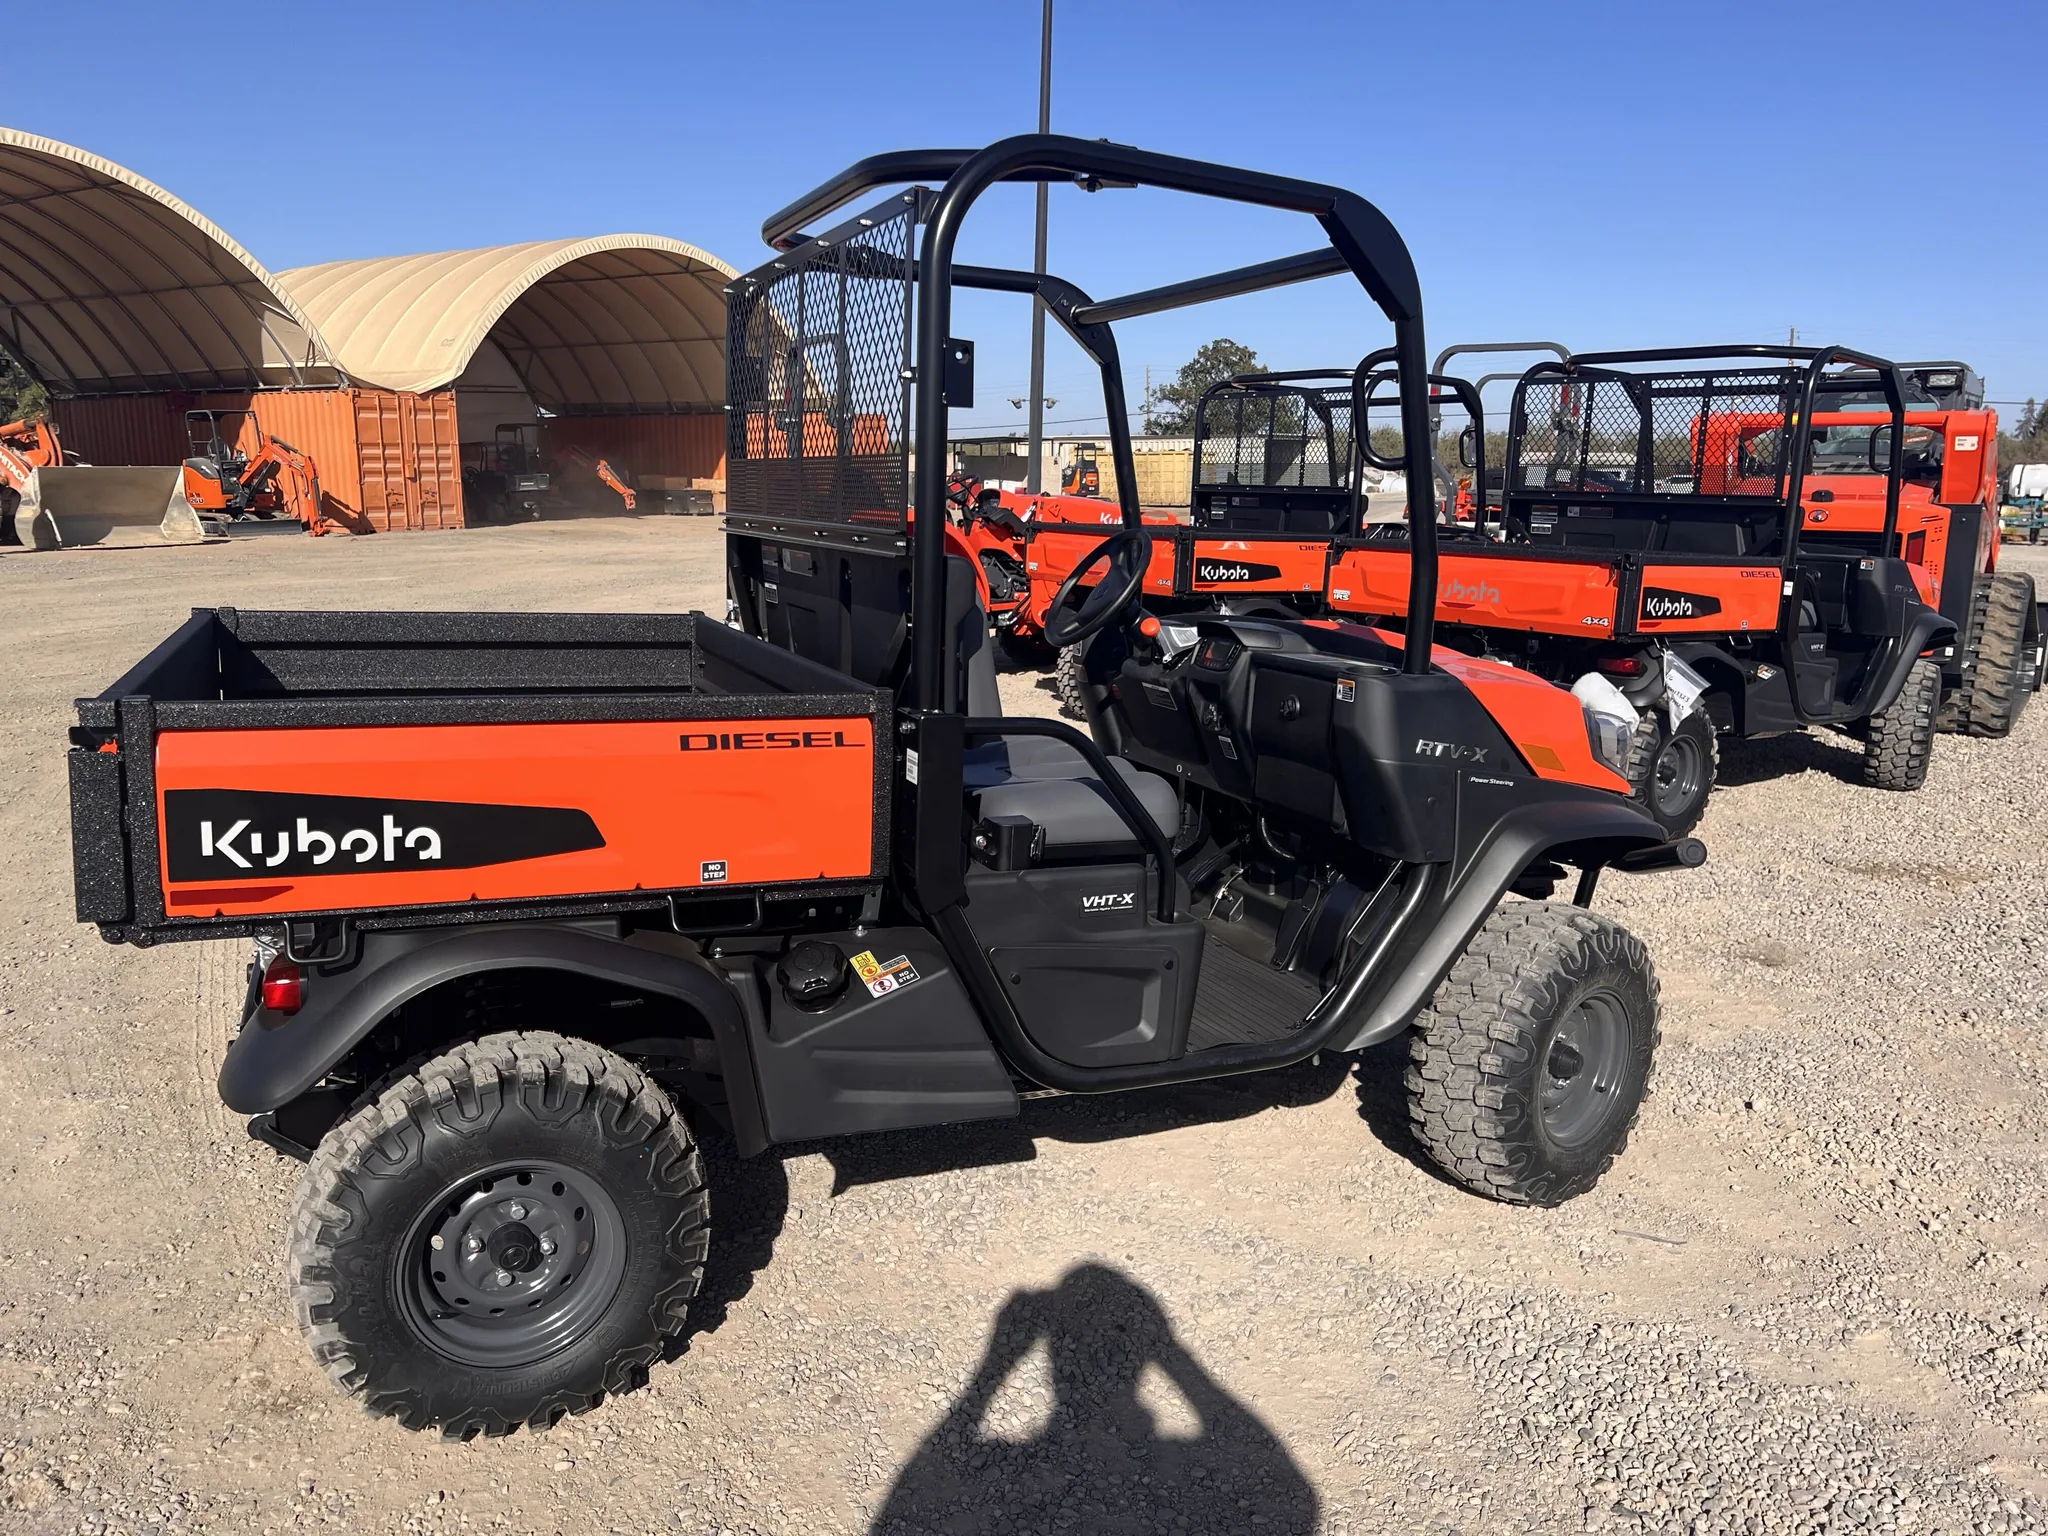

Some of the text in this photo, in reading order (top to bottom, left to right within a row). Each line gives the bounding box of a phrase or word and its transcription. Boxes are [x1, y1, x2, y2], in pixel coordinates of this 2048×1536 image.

[1201, 565, 1249, 580] Kubota
[1740, 570, 1780, 578] DIESEL
[1439, 578, 1499, 603] ubota
[1646, 597, 1693, 617] Kubota
[1581, 616, 1610, 627] 4x4
[680, 732, 865, 751] DIESEL
[1415, 739, 1488, 763] RTV-X
[1470, 776, 1514, 787] Power Steering
[200, 814, 443, 869] Kubota
[708, 863, 721, 871] NO
[703, 871, 725, 879] STEP
[1082, 892, 1135, 908] VHT-X
[898, 973, 915, 983] STEP
[899, 970, 910, 978] NO
